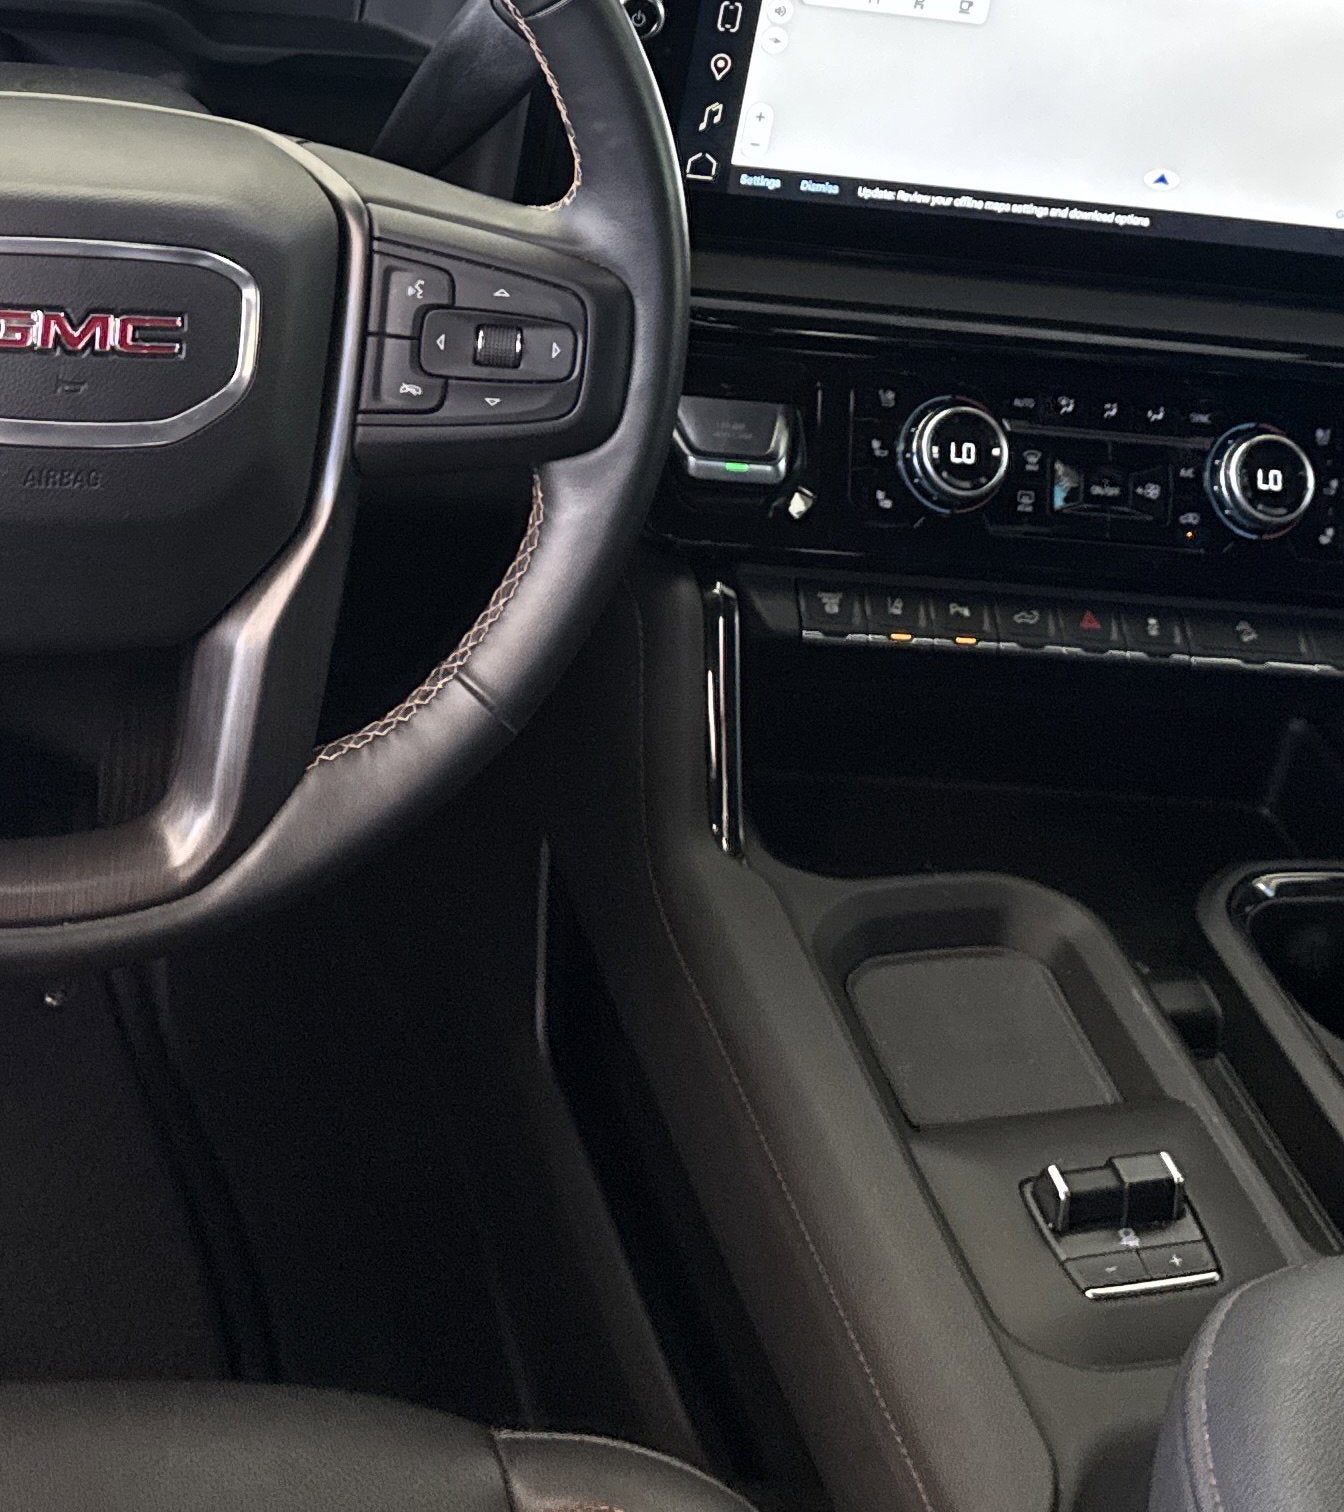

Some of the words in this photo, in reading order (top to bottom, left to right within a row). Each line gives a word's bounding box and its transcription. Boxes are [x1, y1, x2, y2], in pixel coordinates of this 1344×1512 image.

[740, 173, 781, 190] Settings
[800, 179, 840, 195] Dismiss
[930, 195, 953, 207] your
[1011, 202, 1049, 218] settings
[1049, 206, 1069, 218] and
[1069, 208, 1115, 224] download
[950, 442, 975, 465] LO
[23, 469, 101, 489] AIRBAG
[1257, 468, 1282, 492] LO
